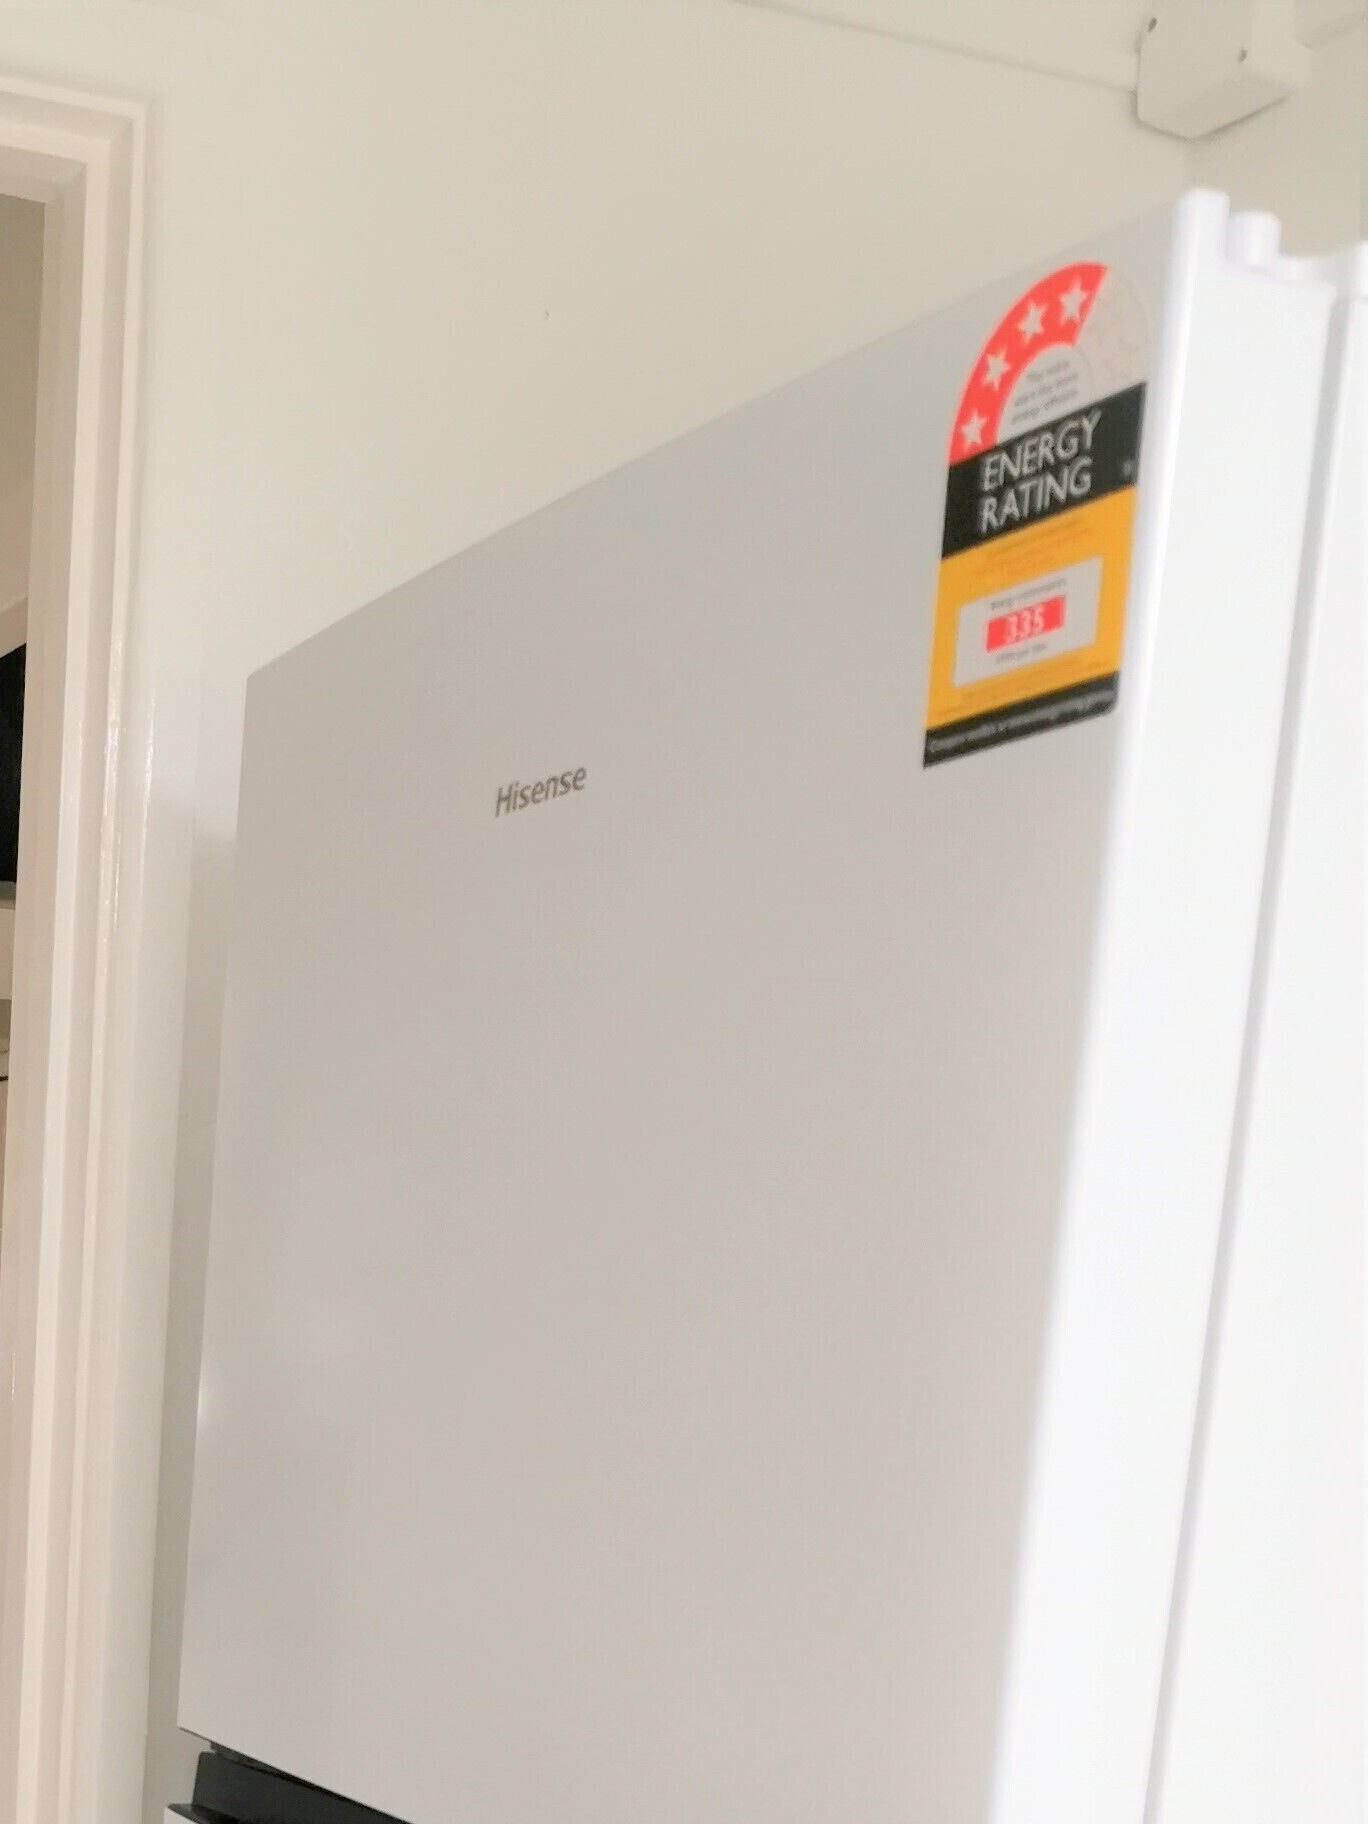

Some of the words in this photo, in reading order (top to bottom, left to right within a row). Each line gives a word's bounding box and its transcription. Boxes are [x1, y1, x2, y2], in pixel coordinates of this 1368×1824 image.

[983, 409, 1102, 492] ENERGY
[980, 455, 1094, 534] RATING
[495, 767, 587, 818] Hisense
